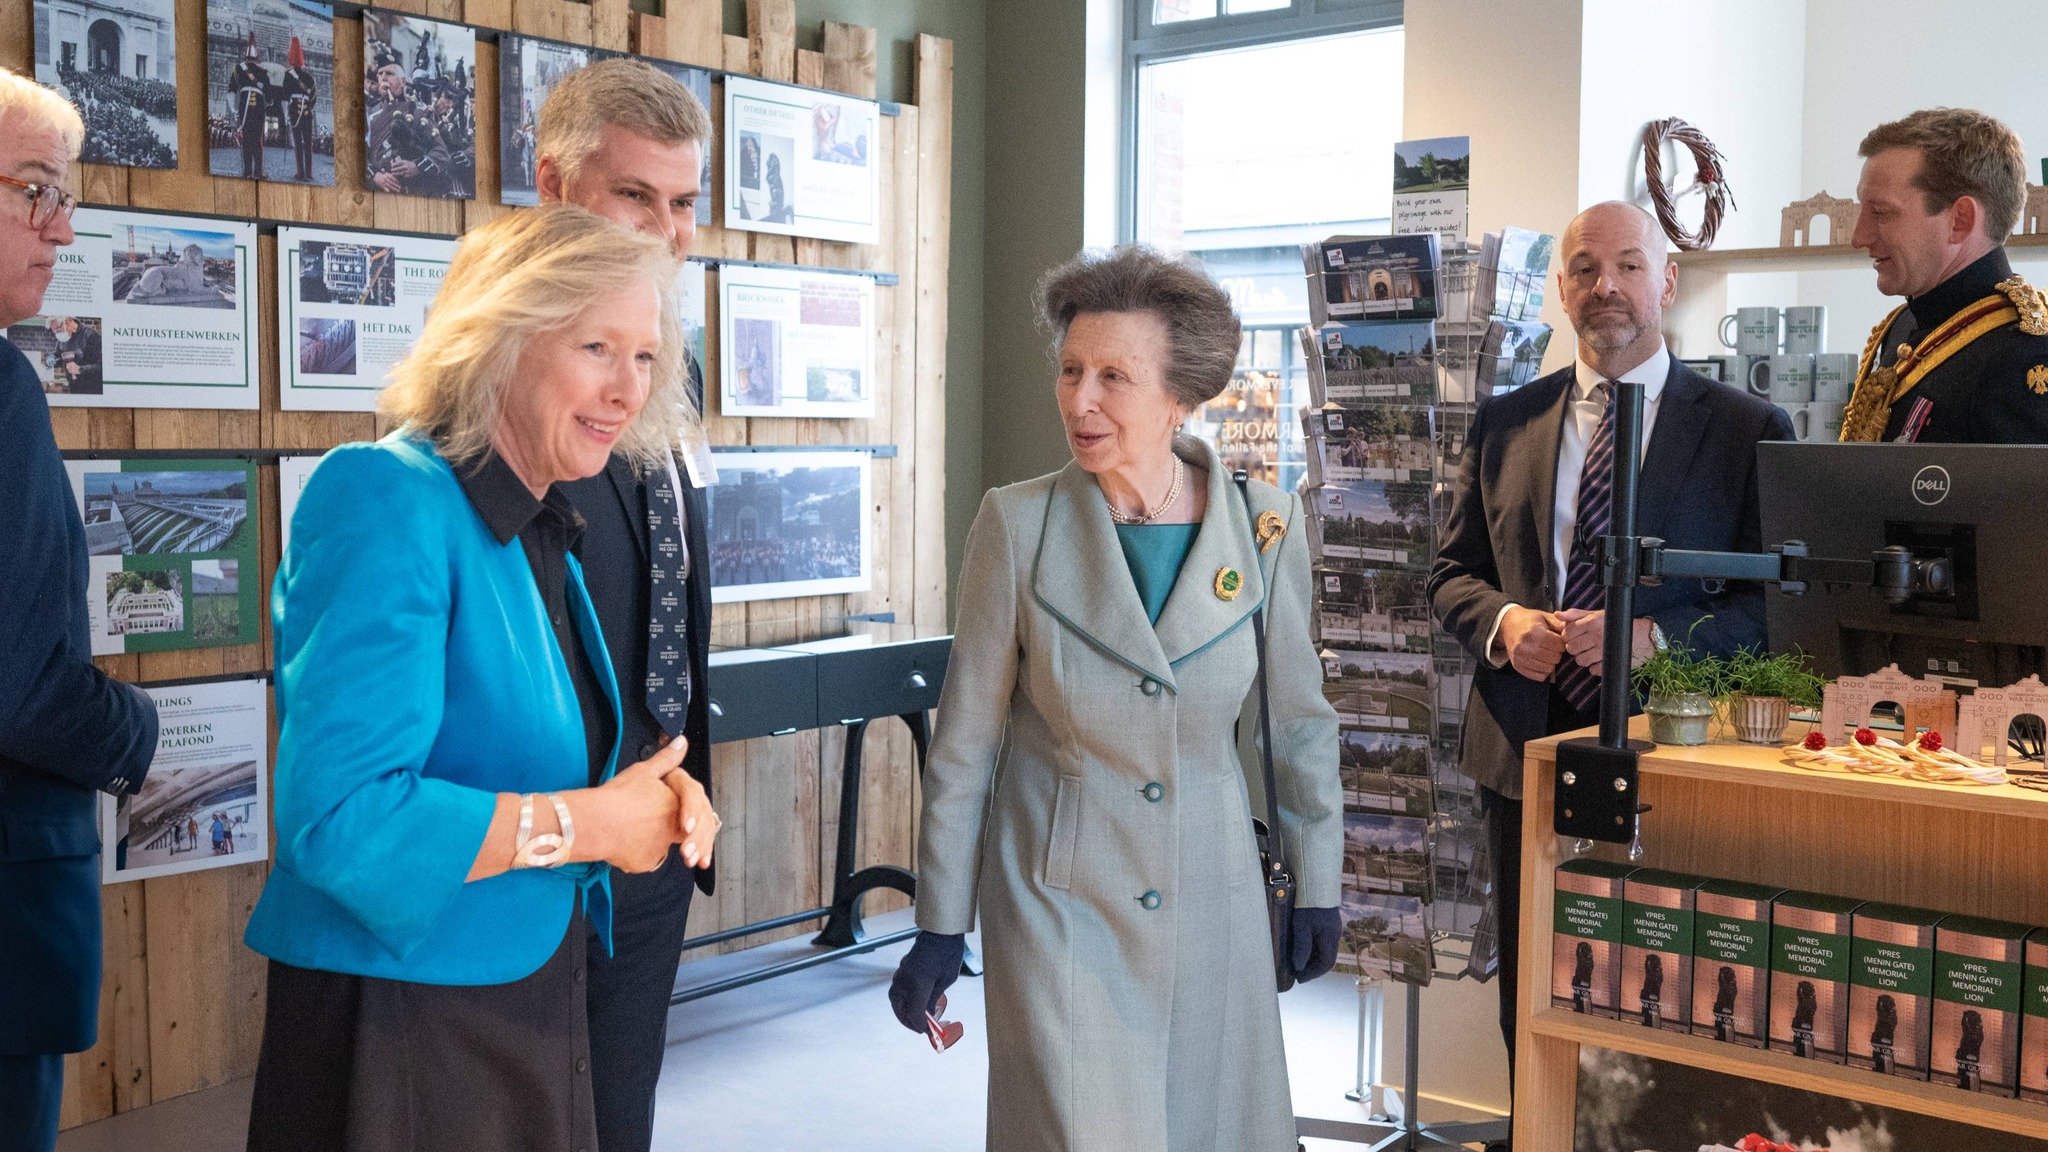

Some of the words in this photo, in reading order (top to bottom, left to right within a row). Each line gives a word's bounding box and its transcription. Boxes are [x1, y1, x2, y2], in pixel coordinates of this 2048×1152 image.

[744, 105, 766, 115] OTHER
[768, 109, 796, 120] DETAILS
[1396, 198, 1410, 206] Build
[1414, 200, 1426, 208] your
[1398, 210, 1427, 221] pilgrimage
[1398, 226, 1410, 234] free
[1414, 225, 1432, 233] folder
[1438, 221, 1462, 232] guides!
[57, 253, 86, 264] ORK
[403, 267, 426, 277] THE
[736, 293, 786, 304] BRICKWORK
[363, 322, 385, 332] HET
[388, 324, 412, 334] DAK
[113, 327, 240, 341] NATUURSTEENWERKEN
[1916, 480, 1946, 490] DELL
[162, 735, 214, 748] PLAFOND
[1576, 900, 1596, 909] YPRES
[1565, 907, 1588, 916] (MENIN
[1589, 910, 1608, 920] GATE)
[1645, 912, 1666, 920] YPRES
[1568, 916, 1602, 928] MEMORIAL
[1634, 918, 1658, 929] (MENIN
[1659, 922, 1678, 932] GATE)
[1720, 922, 1740, 932] YPRES
[1636, 928, 1672, 940] MEMORIAL
[1706, 930, 1732, 940] (MENIN
[1733, 934, 1753, 944] GATE)
[1646, 939, 1663, 947] LION
[1710, 940, 1747, 952] MEMORIAL
[1798, 936, 1820, 946] YPRES
[1720, 951, 1738, 959] LION
[1784, 943, 1811, 954] (MENIN
[1812, 947, 1833, 958] GATE)
[1877, 949, 1901, 959] YPRES
[1788, 953, 1827, 966] MEMORIAL
[1863, 956, 1891, 967] (MENIN
[1892, 961, 1915, 972] GATE)
[1798, 965, 1817, 973] LION
[1867, 966, 1908, 980] MEMORIAL
[1963, 963, 1988, 974] YPRES
[1879, 978, 1898, 988] LION
[1948, 970, 1978, 982] (MENIN
[1979, 976, 2002, 987] GATE)
[1952, 981, 1995, 995] MEMORIAL
[1964, 993, 1984, 1003] LION
